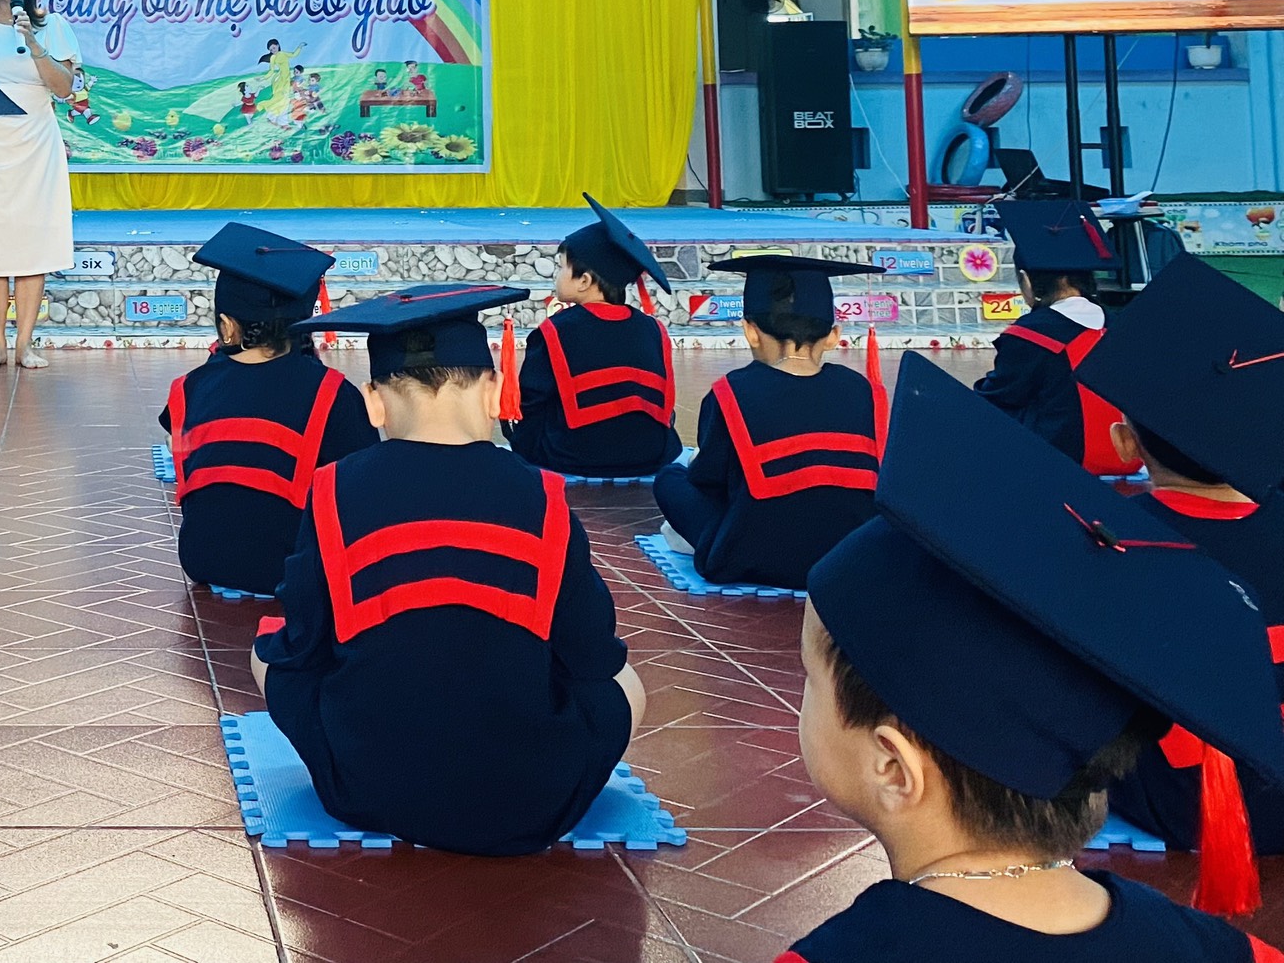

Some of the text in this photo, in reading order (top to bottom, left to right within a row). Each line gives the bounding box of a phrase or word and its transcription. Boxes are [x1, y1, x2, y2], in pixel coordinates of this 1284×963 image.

[793, 111, 834, 120] BEAT
[794, 120, 835, 128] BOX
[81, 257, 103, 269] six
[339, 258, 372, 271] eight
[879, 257, 930, 270] 12 twelve
[132, 301, 150, 314] 18
[727, 308, 744, 318] two
[841, 302, 862, 316] 23
[991, 301, 1012, 313] 24
